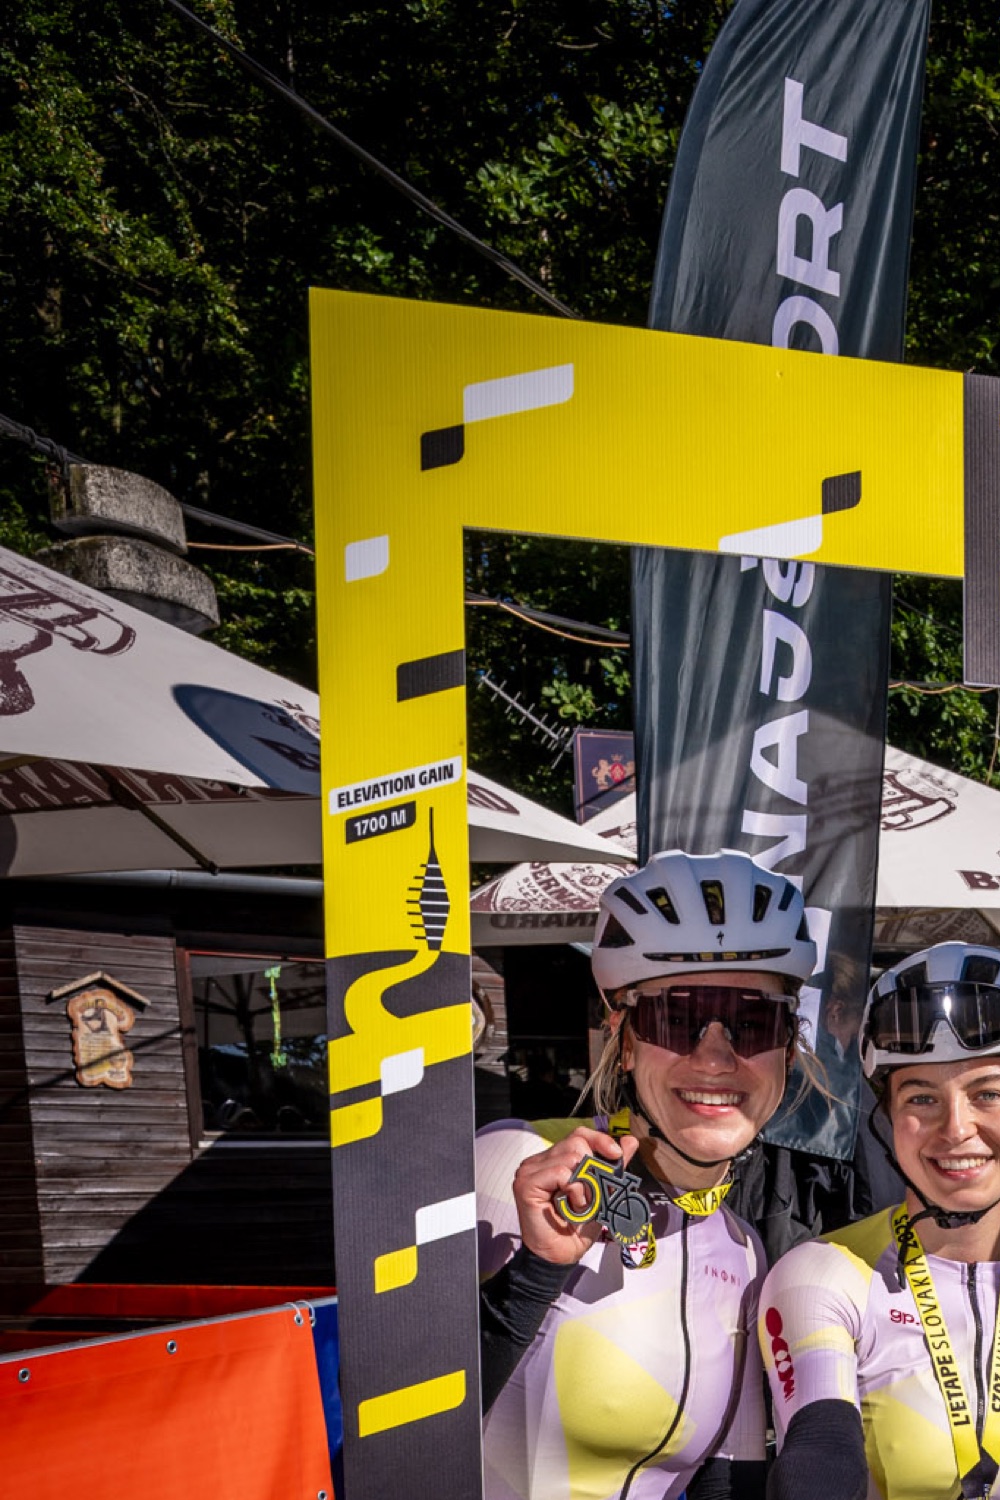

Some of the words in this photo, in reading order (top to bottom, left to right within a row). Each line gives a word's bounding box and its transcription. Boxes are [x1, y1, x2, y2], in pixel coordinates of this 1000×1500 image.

[337, 773, 416, 808] ELEVATION
[419, 763, 454, 785] GAIN
[354, 815, 388, 836] 1700
[391, 809, 407, 827] M
[906, 1254, 950, 1350] SLOVAKIA
[937, 1354, 970, 1426] L'ETAPE
